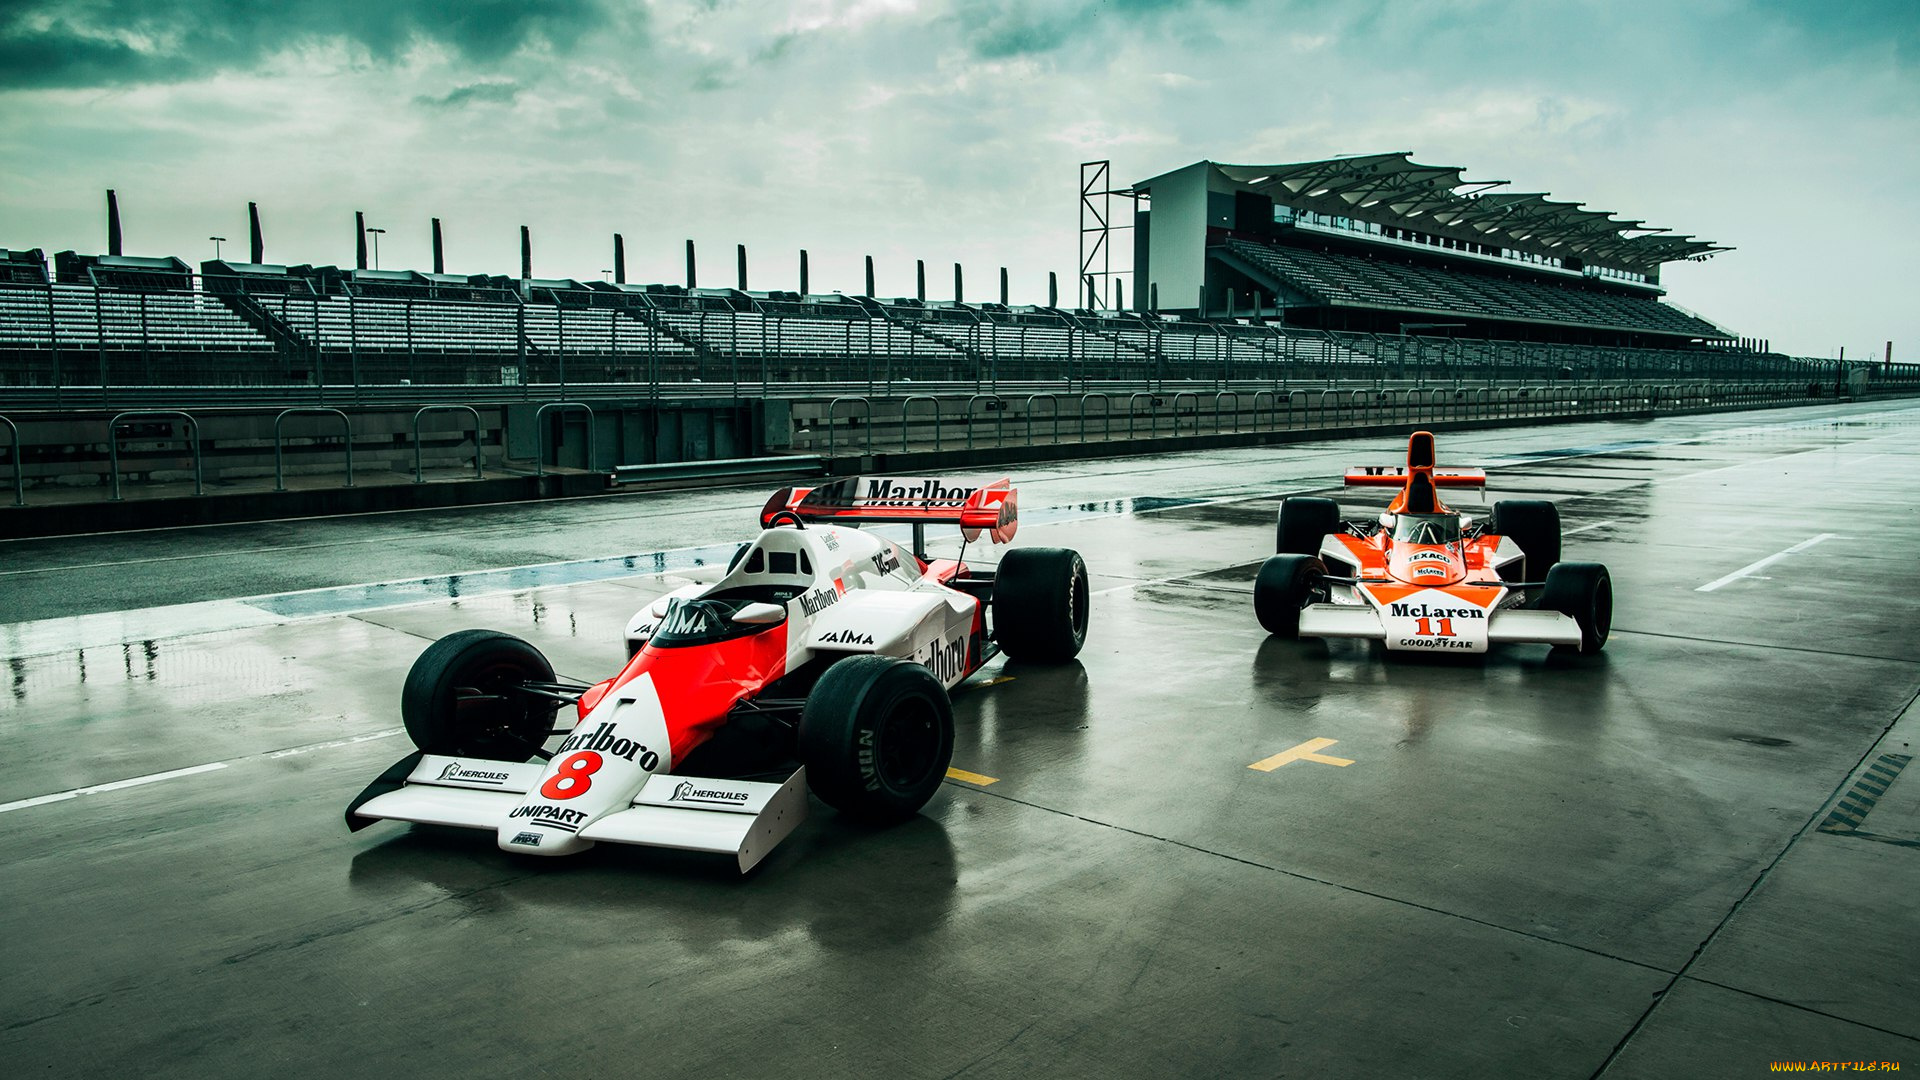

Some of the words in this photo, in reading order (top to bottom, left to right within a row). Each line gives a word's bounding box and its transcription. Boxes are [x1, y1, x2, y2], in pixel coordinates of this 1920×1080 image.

[864, 480, 977, 507] Marlbor
[1409, 553, 1450, 563] TEXACO
[1417, 568, 1444, 576] McLaren
[800, 588, 838, 617] Marlboro
[1391, 603, 1484, 618] McLaren
[662, 604, 707, 635] AIMA
[1415, 617, 1457, 637] 11
[818, 629, 874, 645] SAIMA
[556, 722, 659, 772] arlboro
[458, 765, 509, 780] HERCULES
[540, 750, 603, 800] 8
[692, 789, 749, 801] HERCULES
[509, 805, 588, 825] UNIPART
